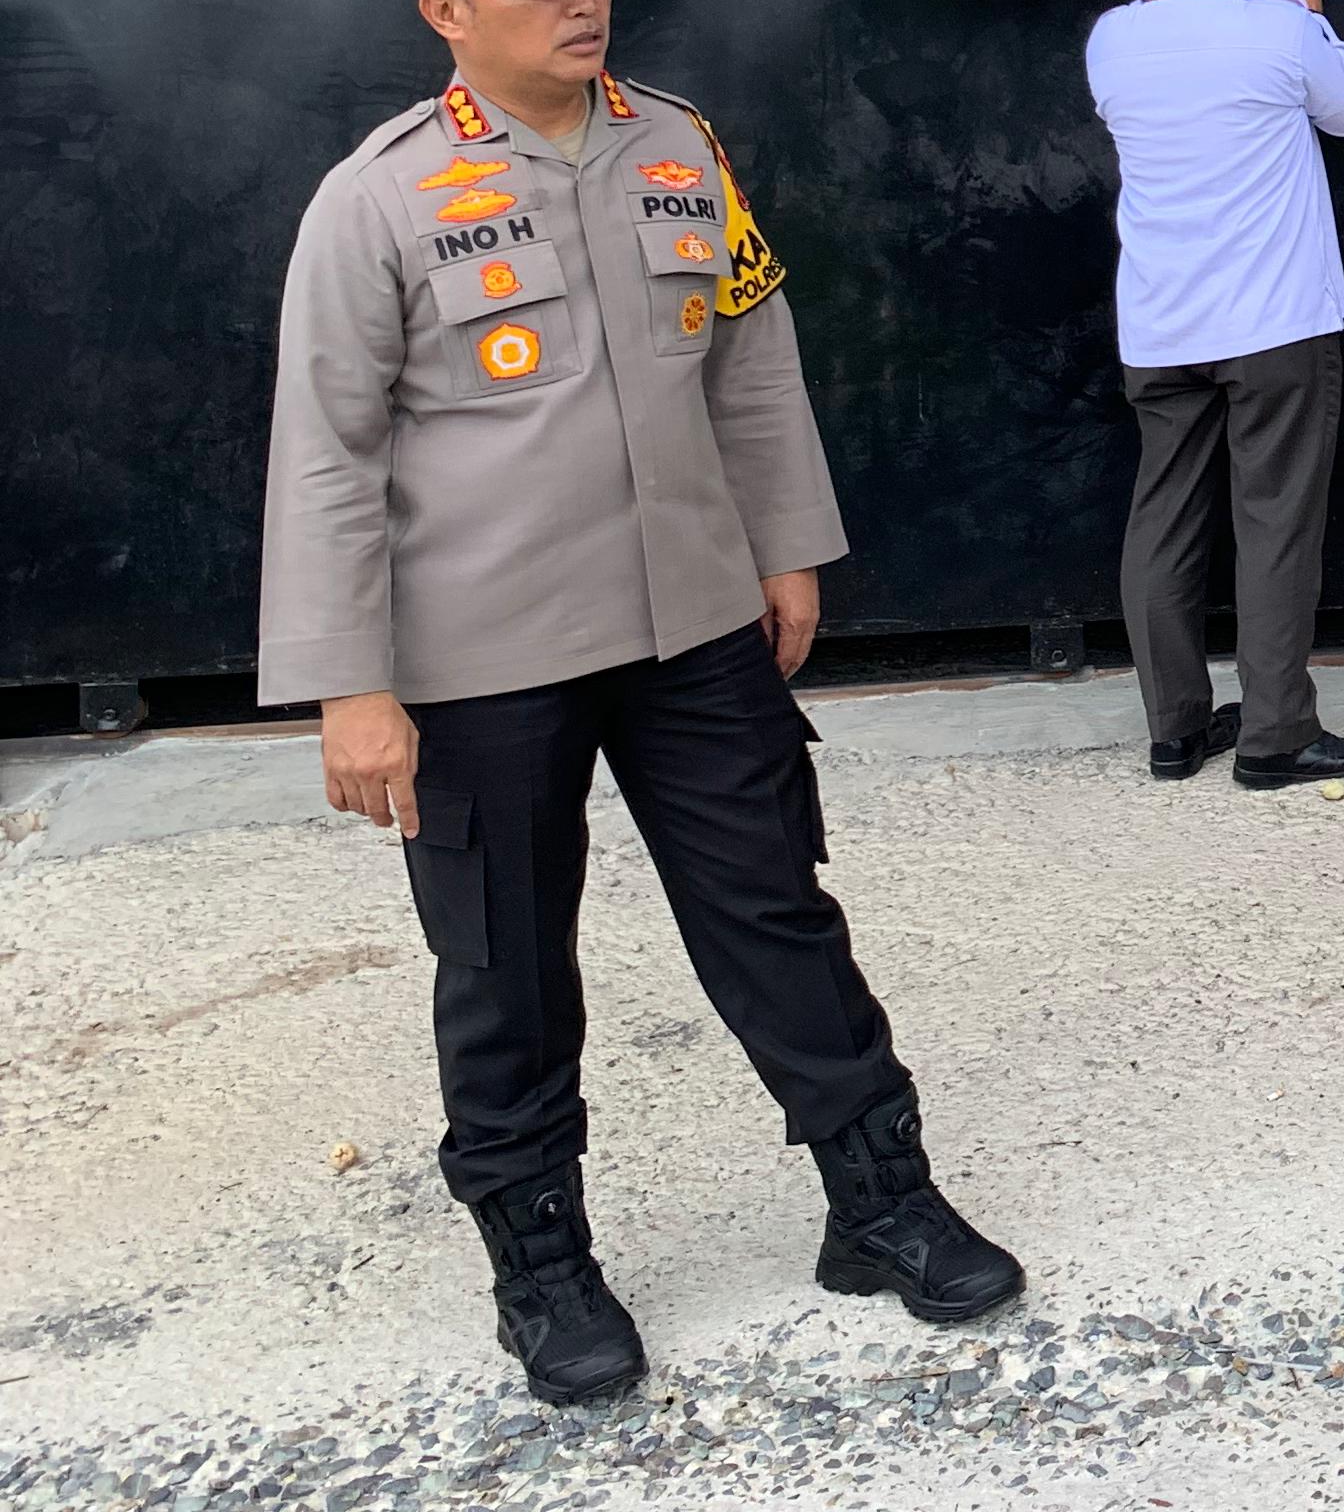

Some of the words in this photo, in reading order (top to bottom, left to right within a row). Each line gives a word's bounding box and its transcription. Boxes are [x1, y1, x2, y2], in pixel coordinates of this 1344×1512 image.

[642, 195, 718, 221] POLRI
[434, 225, 499, 261] INO
[508, 216, 535, 242] H
